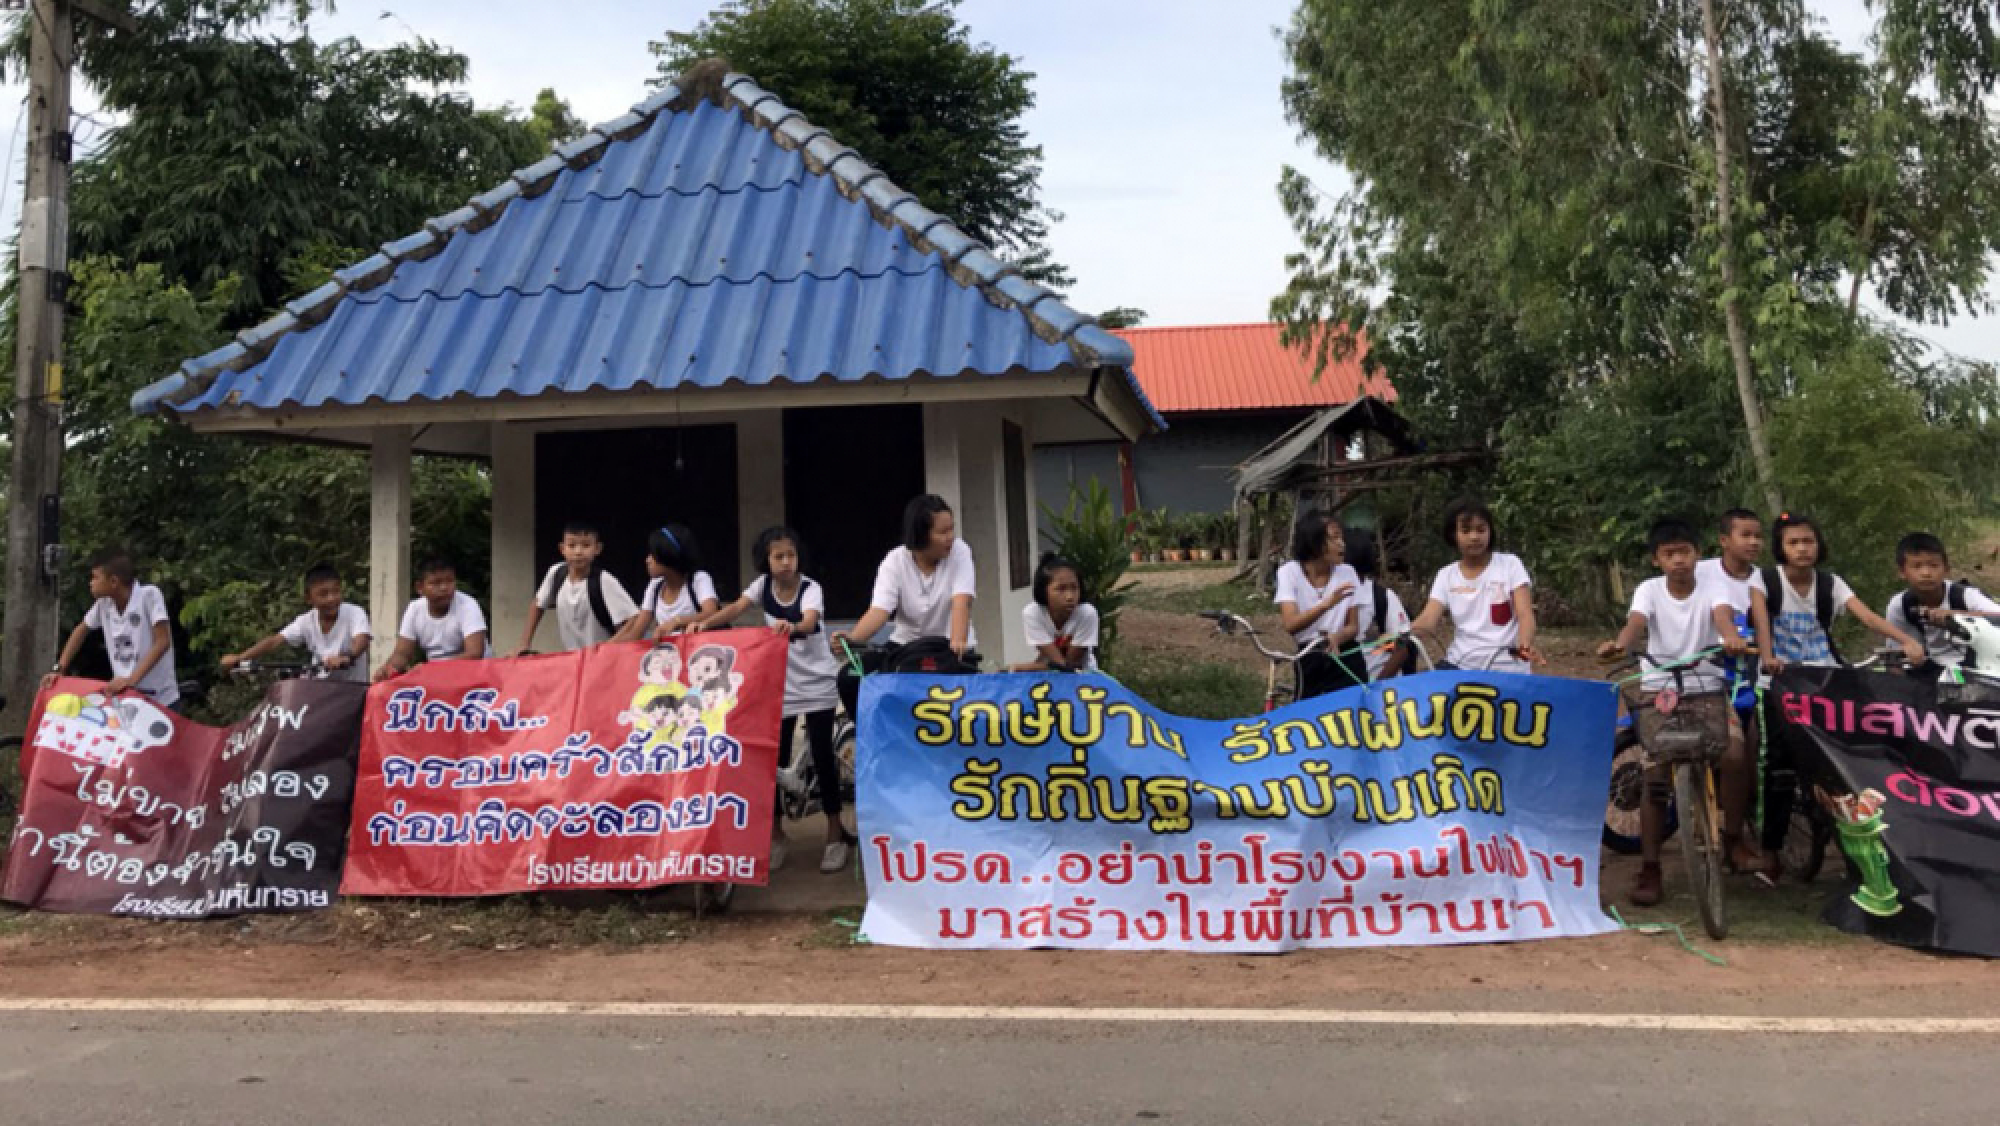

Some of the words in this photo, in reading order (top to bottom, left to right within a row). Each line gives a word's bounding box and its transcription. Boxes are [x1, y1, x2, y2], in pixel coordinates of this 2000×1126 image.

[383, 686, 548, 732] นึกถึง...
[912, 682, 1189, 760] รักษ์บ้าน
[1222, 682, 1552, 764] รักแผ่นดิน
[382, 726, 741, 789] ครอบครัวสักนิด
[368, 792, 749, 846] ก่อนคิดจะลองยา
[950, 747, 1506, 834] รักถิ่นฐานบ้านเกิด
[872, 826, 1585, 887] โปรด..อย่านำโรงงานไฟฟาฯ
[938, 884, 1555, 943] มาสร้างในพื้นที่บ้านเา
